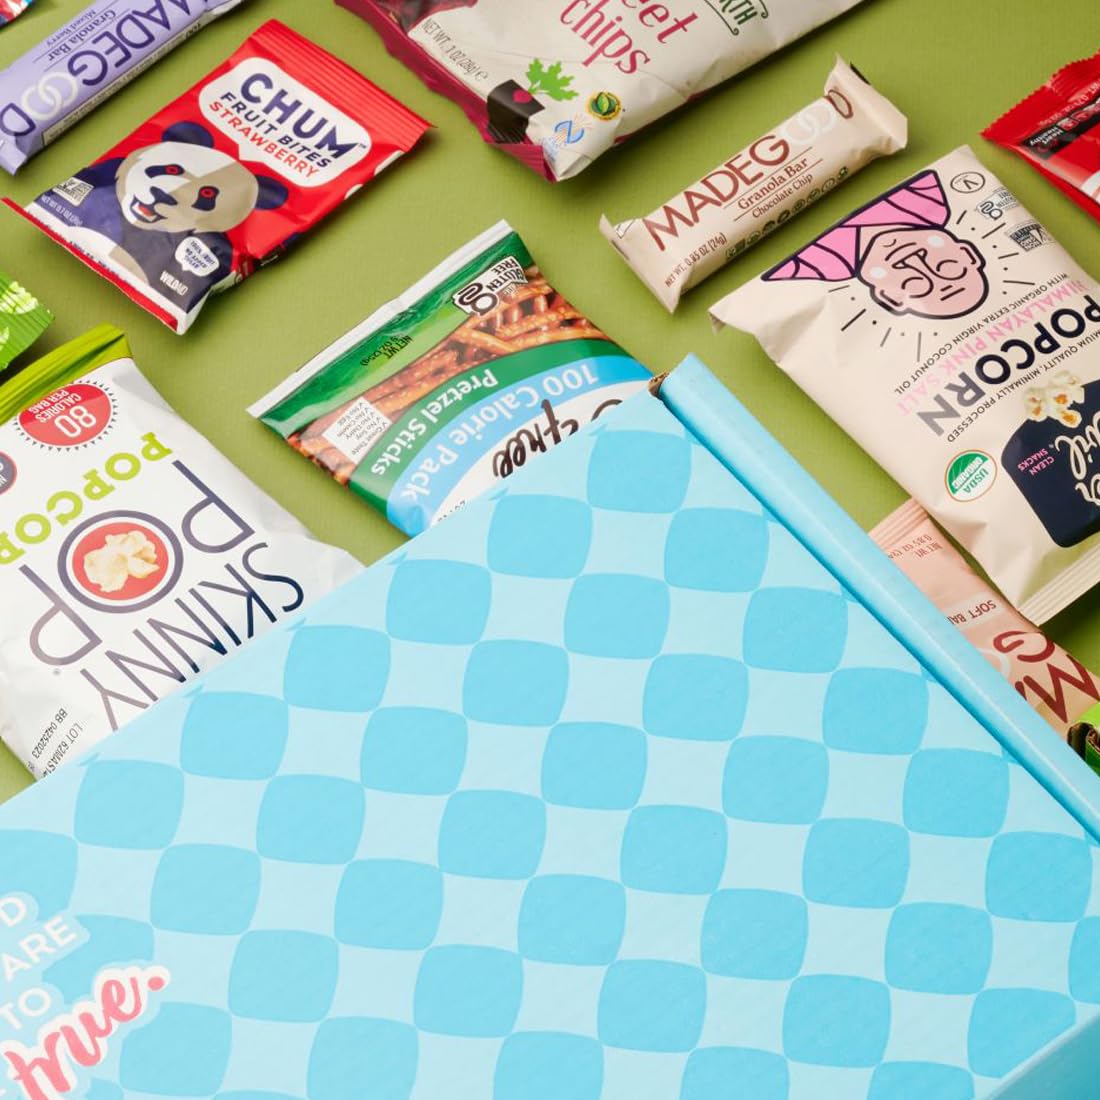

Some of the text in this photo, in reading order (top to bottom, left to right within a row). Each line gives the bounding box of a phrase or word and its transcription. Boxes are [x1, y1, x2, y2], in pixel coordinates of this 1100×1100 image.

[69, 9, 116, 45] Granola
[209, 101, 319, 178] STRAWBERRY
[220, 92, 331, 167] FRUIT BITES
[241, 73, 358, 159] CHUM
[738, 157, 808, 210] Granola Bar
[752, 173, 813, 218] Chocolate Chip
[423, 369, 499, 423] Pretzel
[542, 364, 598, 396] 100
[35, 393, 81, 423] CALORIES
[54, 405, 96, 438] 80
[453, 388, 539, 445] Calorie
[371, 420, 428, 476] Sticks
[400, 445, 458, 502] Pack
[81, 542, 304, 732] SKINNY
